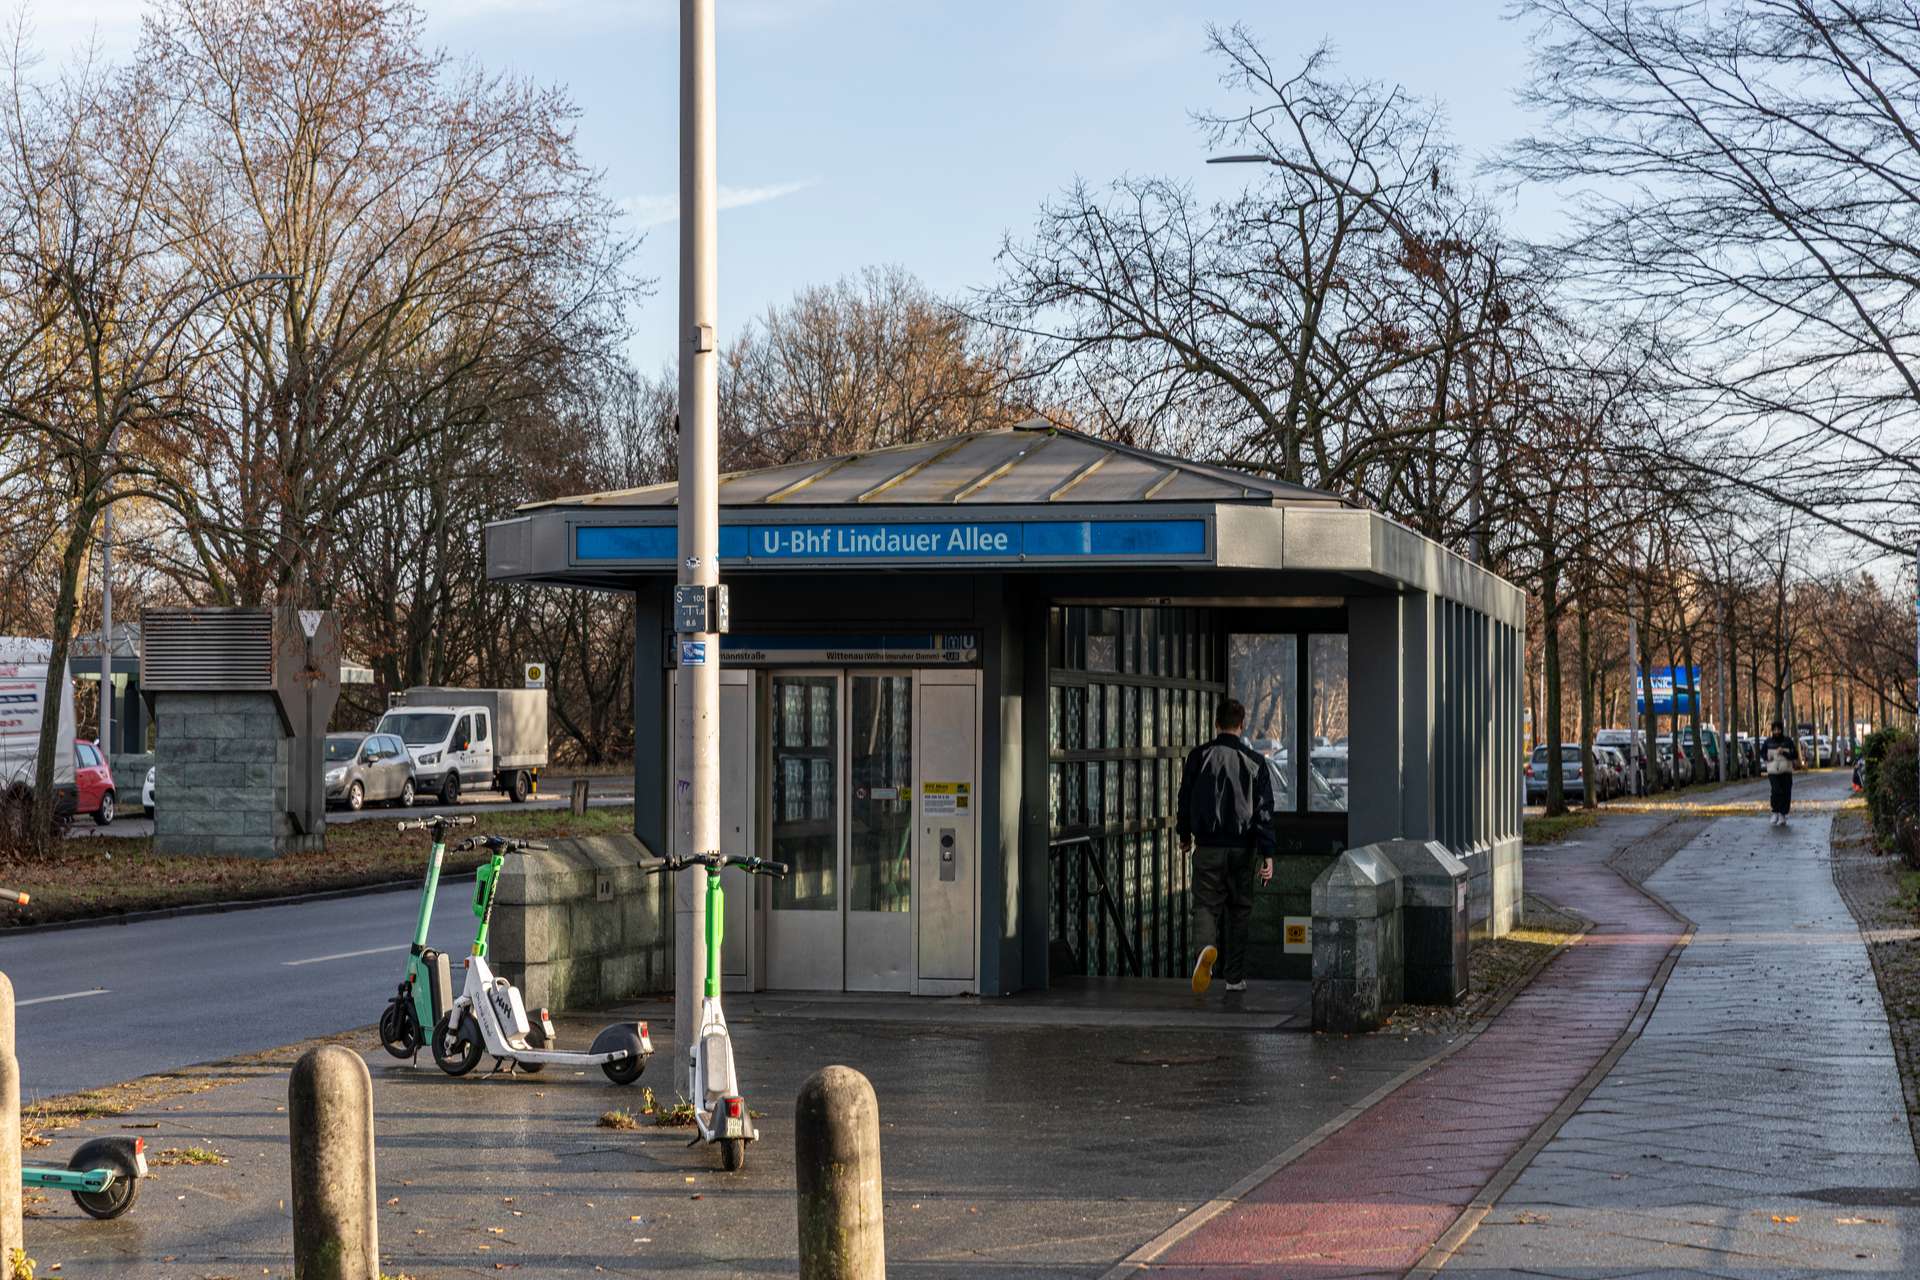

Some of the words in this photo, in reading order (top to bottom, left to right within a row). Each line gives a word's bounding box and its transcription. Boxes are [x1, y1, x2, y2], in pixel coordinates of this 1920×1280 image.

[763, 528, 832, 554] U-Bhf
[837, 527, 942, 553] Lindauer
[946, 526, 1009, 551] Allee
[676, 591, 683, 603] S
[692, 594, 705, 603] 100
[719, 651, 767, 661] mannstraße
[826, 651, 864, 661] Wittenau
